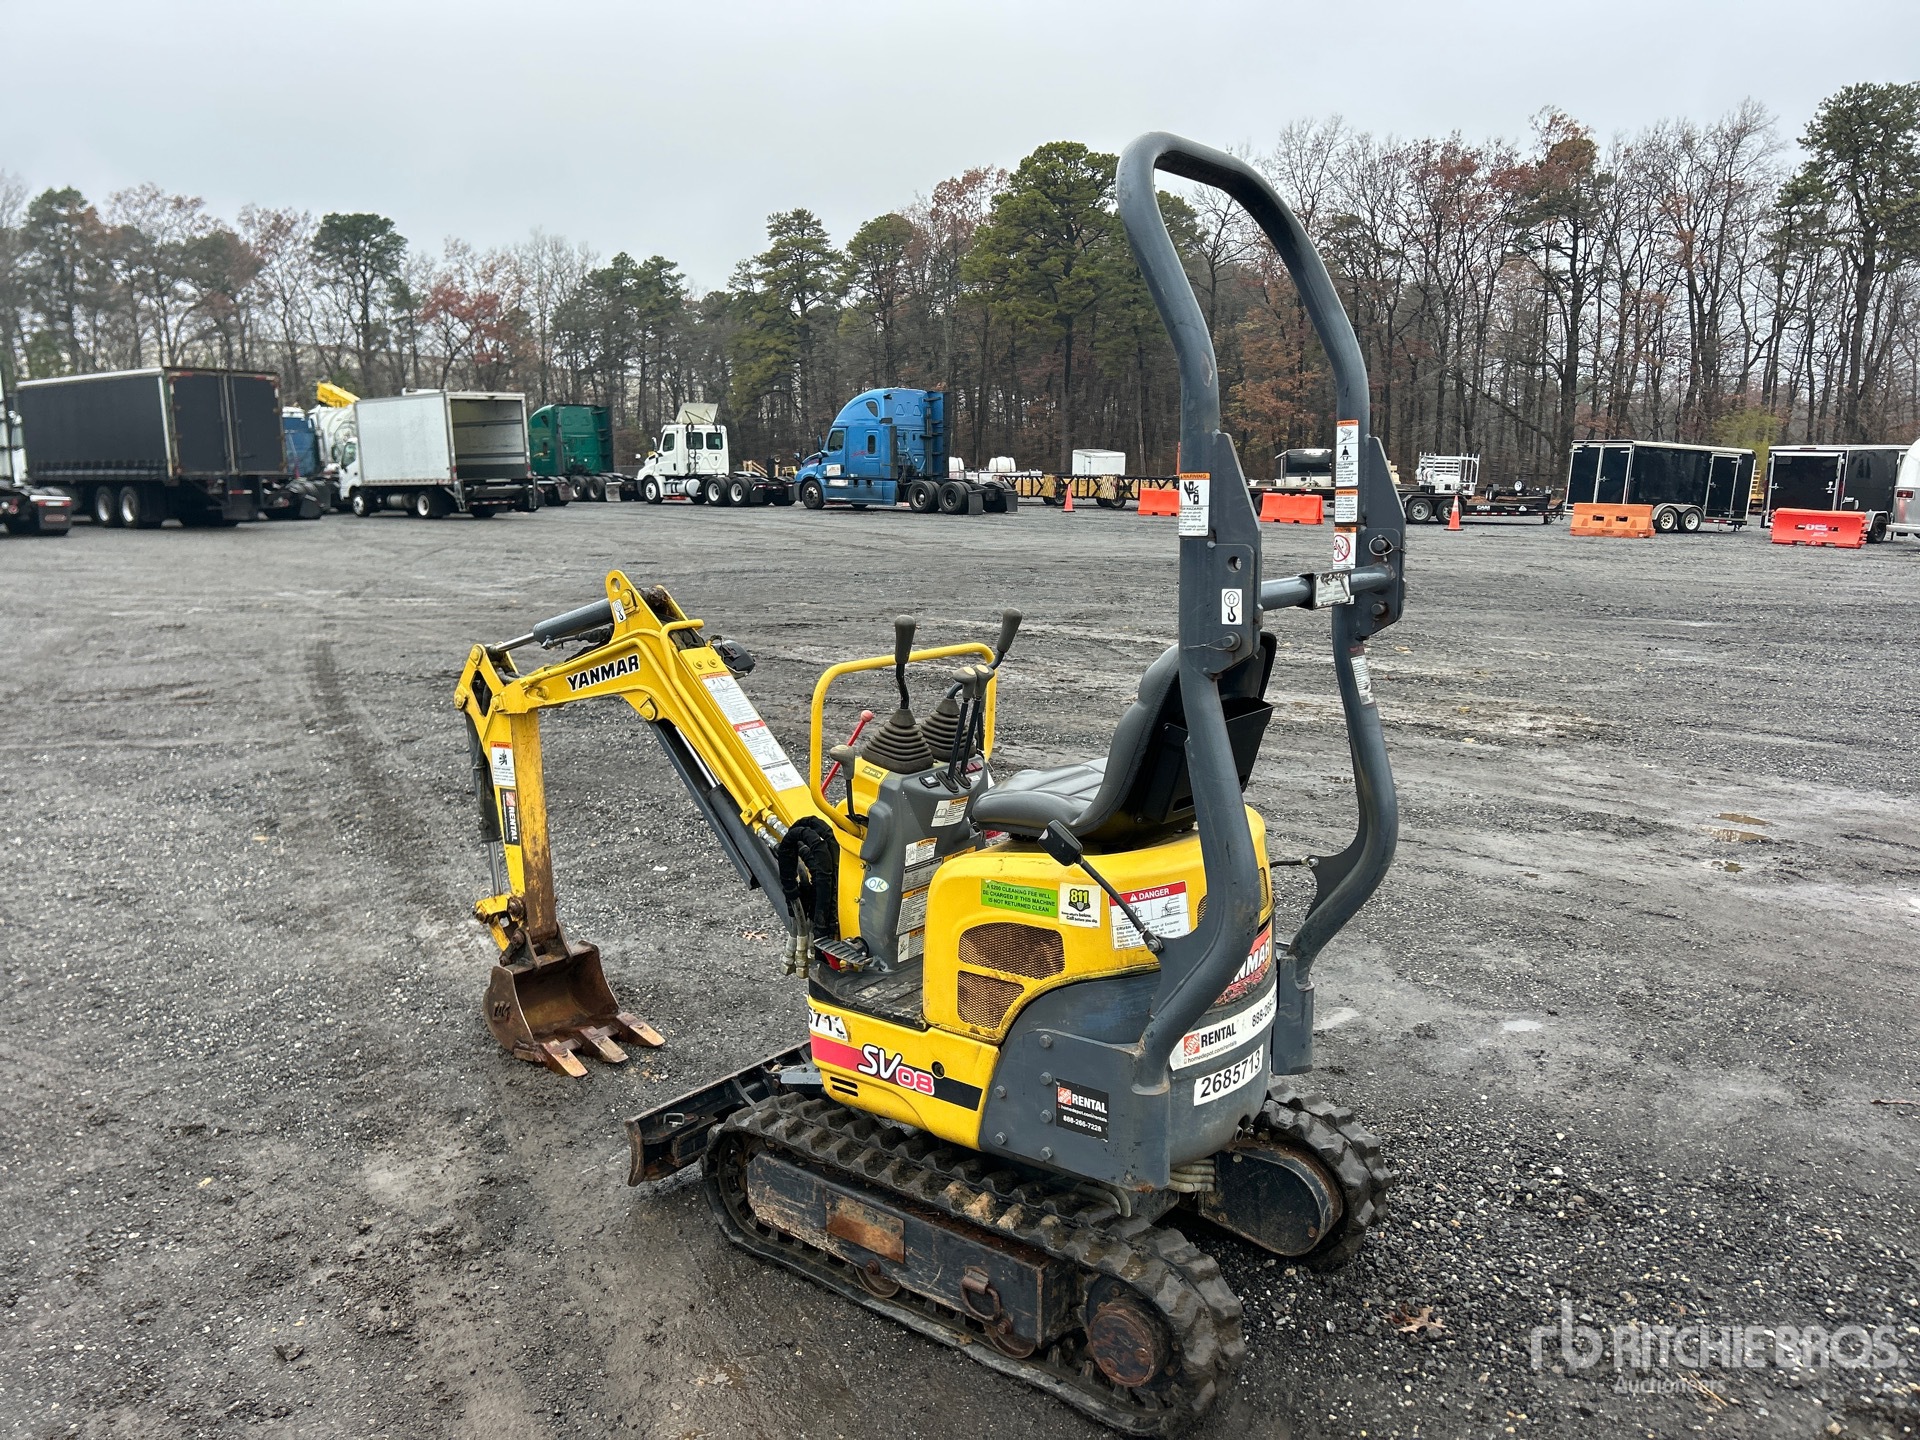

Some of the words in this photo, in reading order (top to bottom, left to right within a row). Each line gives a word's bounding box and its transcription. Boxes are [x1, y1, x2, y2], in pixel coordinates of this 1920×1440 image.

[567, 654, 639, 691] YANMAR
[508, 806, 518, 842] RENTAL
[869, 878, 884, 891] OK
[1002, 886, 1027, 896] CLEANING
[1038, 892, 1052, 900] WILL
[1138, 887, 1170, 901] DANGER
[989, 890, 1014, 900] CHARGED
[1020, 895, 1031, 903] THIS
[1031, 897, 1056, 907] MACHINE
[1004, 899, 1032, 910] RETURNED
[1031, 905, 1050, 913] CLEAN
[1070, 889, 1089, 904] 811
[1200, 1022, 1237, 1049] RENTAL
[857, 1043, 936, 1096] SV08
[1200, 1054, 1261, 1099] 2685713
[1071, 1093, 1108, 1115] RENTAL
